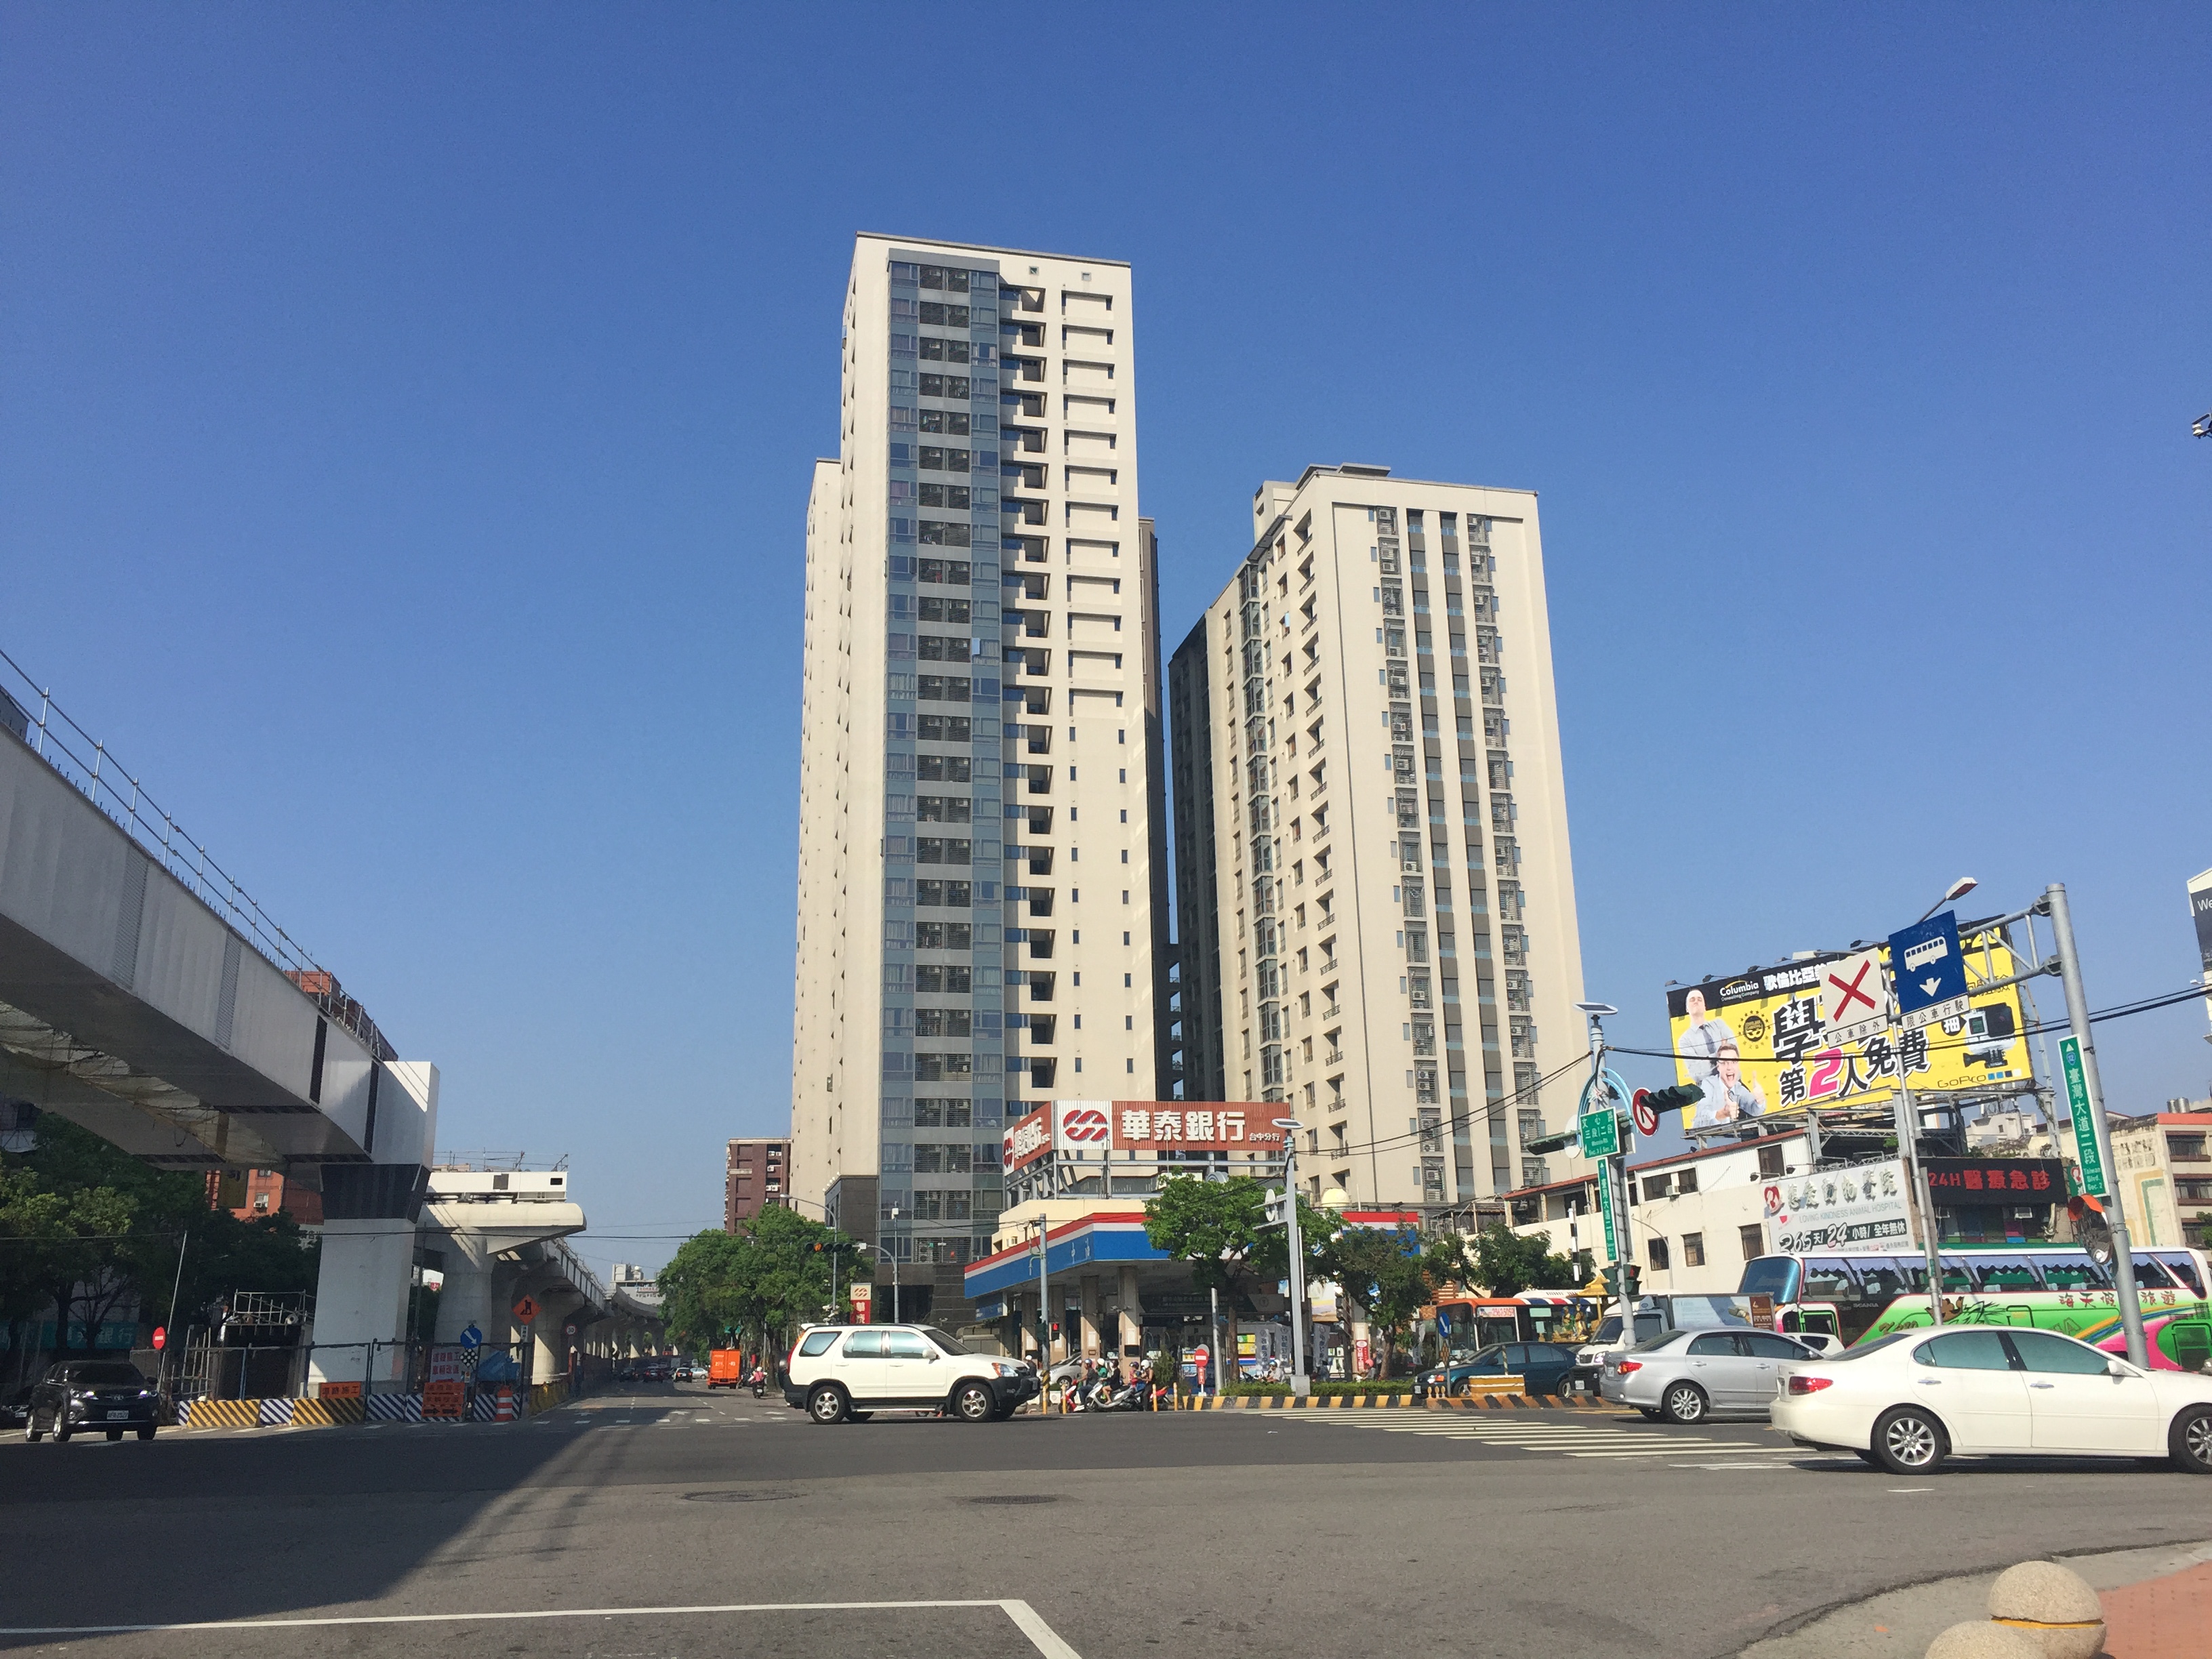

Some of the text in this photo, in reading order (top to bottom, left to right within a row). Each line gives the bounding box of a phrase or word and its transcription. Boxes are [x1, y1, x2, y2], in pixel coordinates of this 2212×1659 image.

[1719, 981, 1759, 997] Columbia
[1906, 999, 1965, 1028] 限公車行駛
[1835, 1021, 1881, 1043] 公車除外
[1937, 1073, 1986, 1089] GoPro
[1122, 1109, 1246, 1141] 華泰銀行
[2069, 1067, 2096, 1164] 臺灣大道二段
[1249, 1132, 1281, 1142] 台中分行
[1799, 1213, 1820, 1223] LOVING
[1820, 1210, 1849, 1221] KINDNESS
[1849, 1205, 1872, 1216] ANIMAL
[1872, 1202, 1902, 1213] HOSPITAL
[2059, 1290, 2176, 1309] 海天假旅遊
